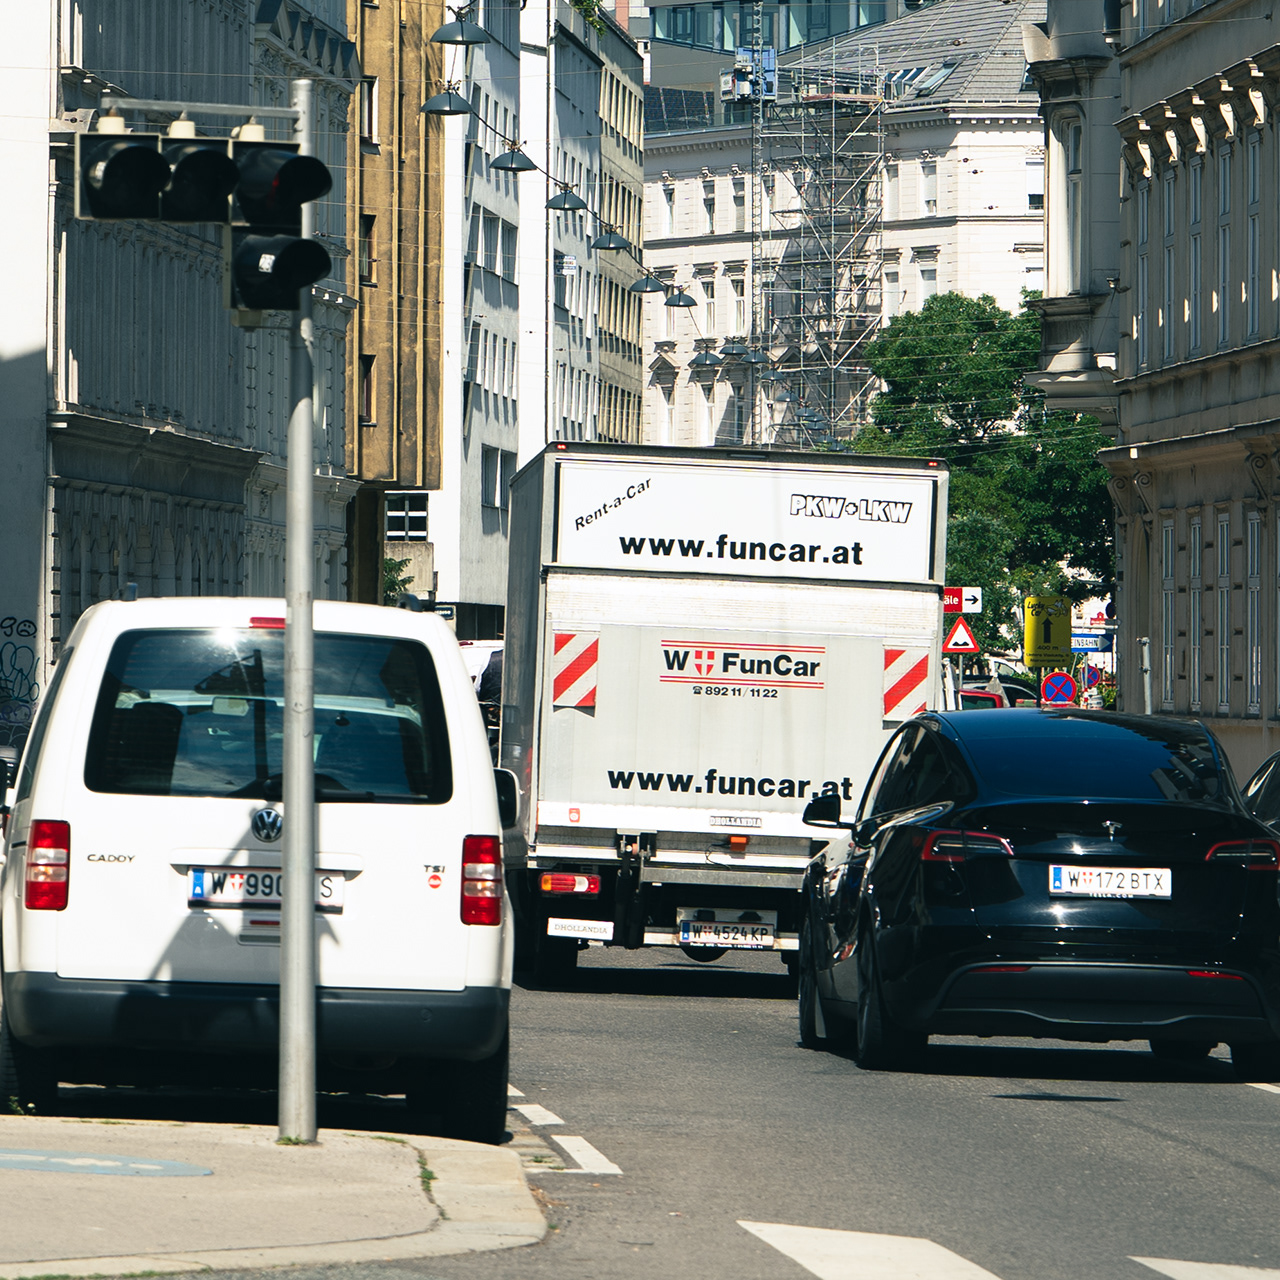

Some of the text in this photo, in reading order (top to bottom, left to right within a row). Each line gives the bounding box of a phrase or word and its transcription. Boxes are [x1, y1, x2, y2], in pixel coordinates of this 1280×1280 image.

[575, 477, 652, 531] Rent-a-Car
[619, 534, 864, 566] www.funcar.at
[1071, 637, 1098, 647] INBAHN
[663, 649, 821, 677] W FunCar
[705, 686, 729, 696] 892
[607, 768, 853, 801] www.funcar.at
[709, 815, 763, 828] DHOLLANDIA
[86, 853, 136, 863] CADDY
[423, 864, 446, 874] TSI
[210, 872, 225, 895] W
[1068, 871, 1080, 887] W
[1096, 872, 1125, 888] 172
[554, 923, 608, 935] DHOLLANDIA
[692, 924, 703, 939] W
[713, 925, 748, 941] 4524
